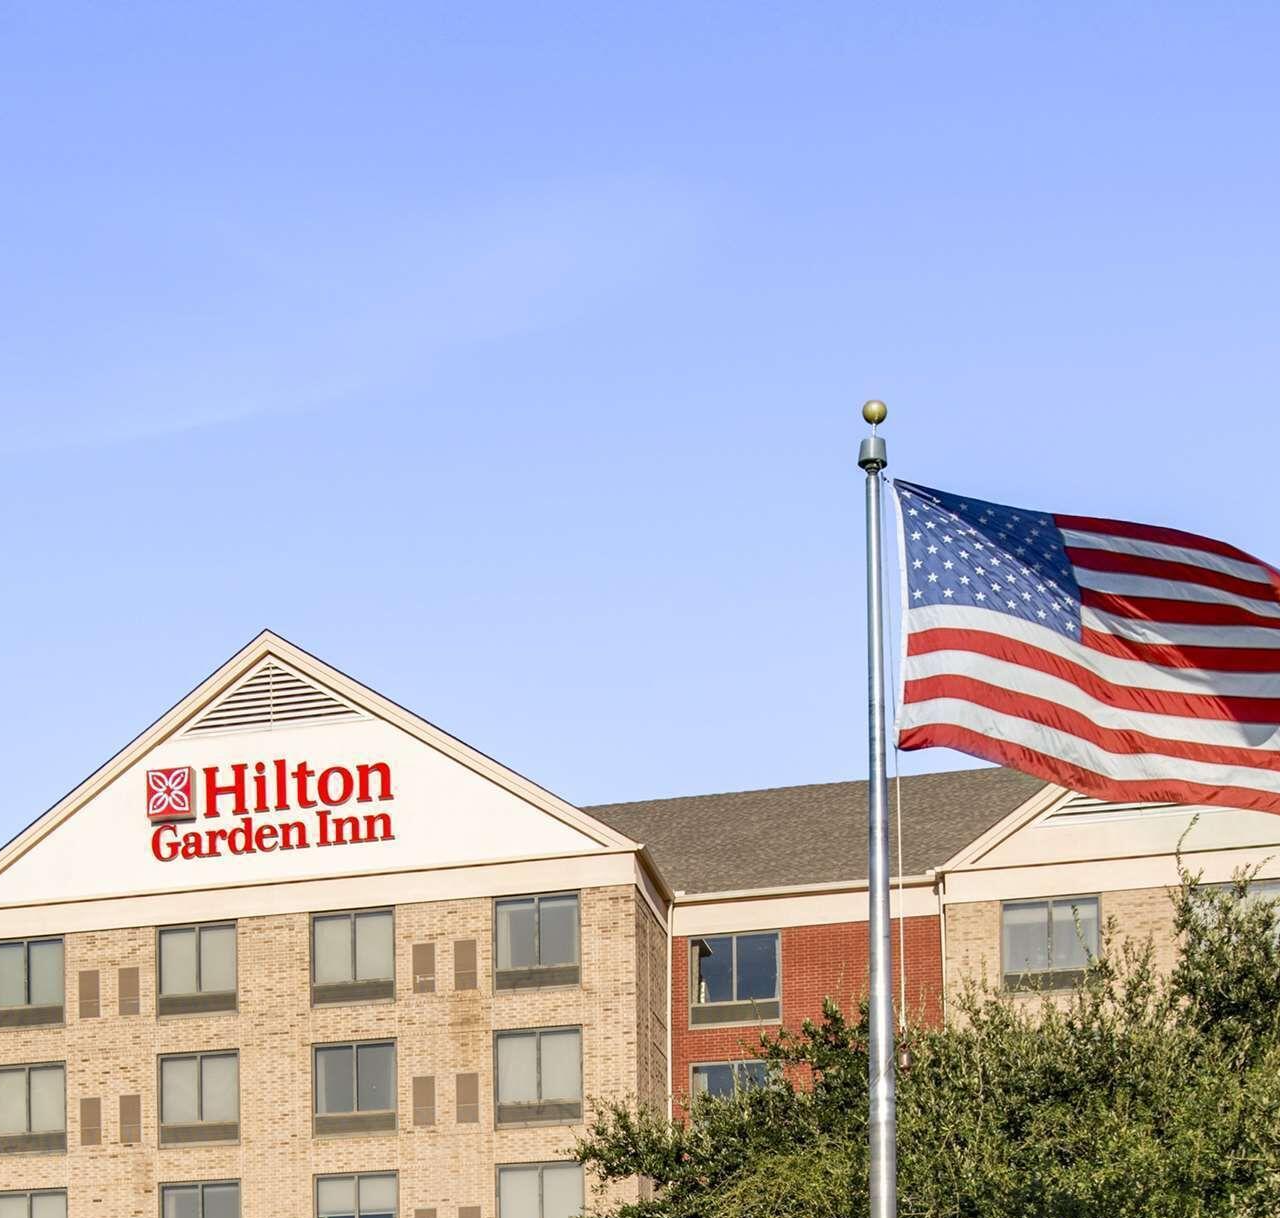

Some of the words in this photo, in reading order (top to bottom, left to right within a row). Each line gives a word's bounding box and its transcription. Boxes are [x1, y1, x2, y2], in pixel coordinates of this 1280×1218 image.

[203, 759, 395, 819] Hilton
[151, 817, 310, 862] Garden
[315, 809, 395, 847] Inn
